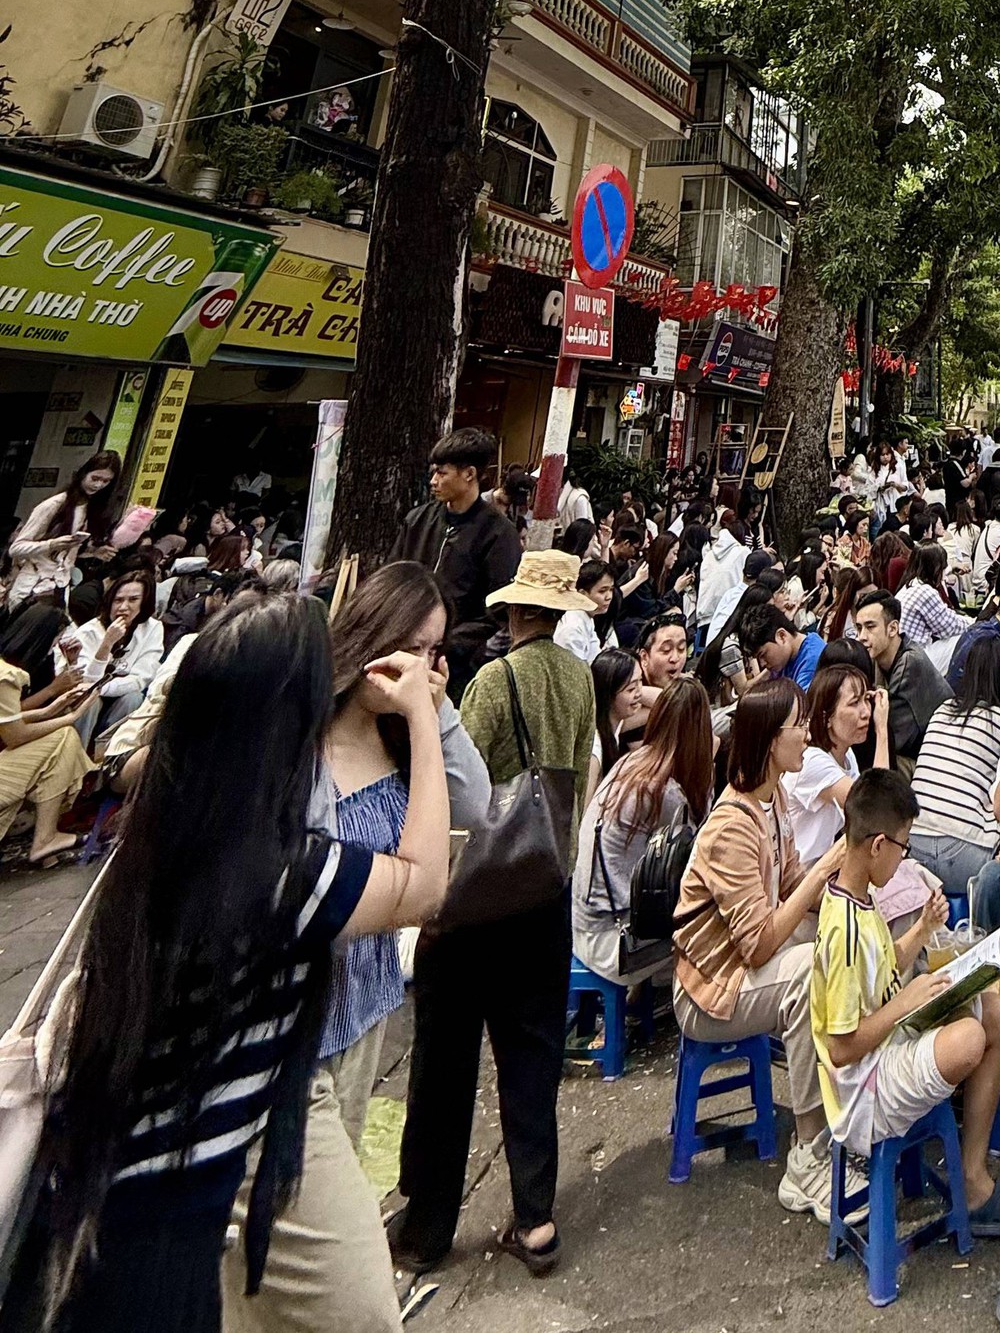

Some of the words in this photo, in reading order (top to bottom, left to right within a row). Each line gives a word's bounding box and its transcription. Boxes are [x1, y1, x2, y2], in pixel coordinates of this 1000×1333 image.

[43, 214, 196, 289] Coffee
[25, 291, 87, 320] NHÀ
[88, 299, 144, 327] THỜ
[240, 300, 314, 337] TRÀ
[574, 294, 591, 313] KHU
[592, 297, 607, 318] VỰC
[22, 326, 70, 342] CHUNG
[599, 330, 609, 347] XE
